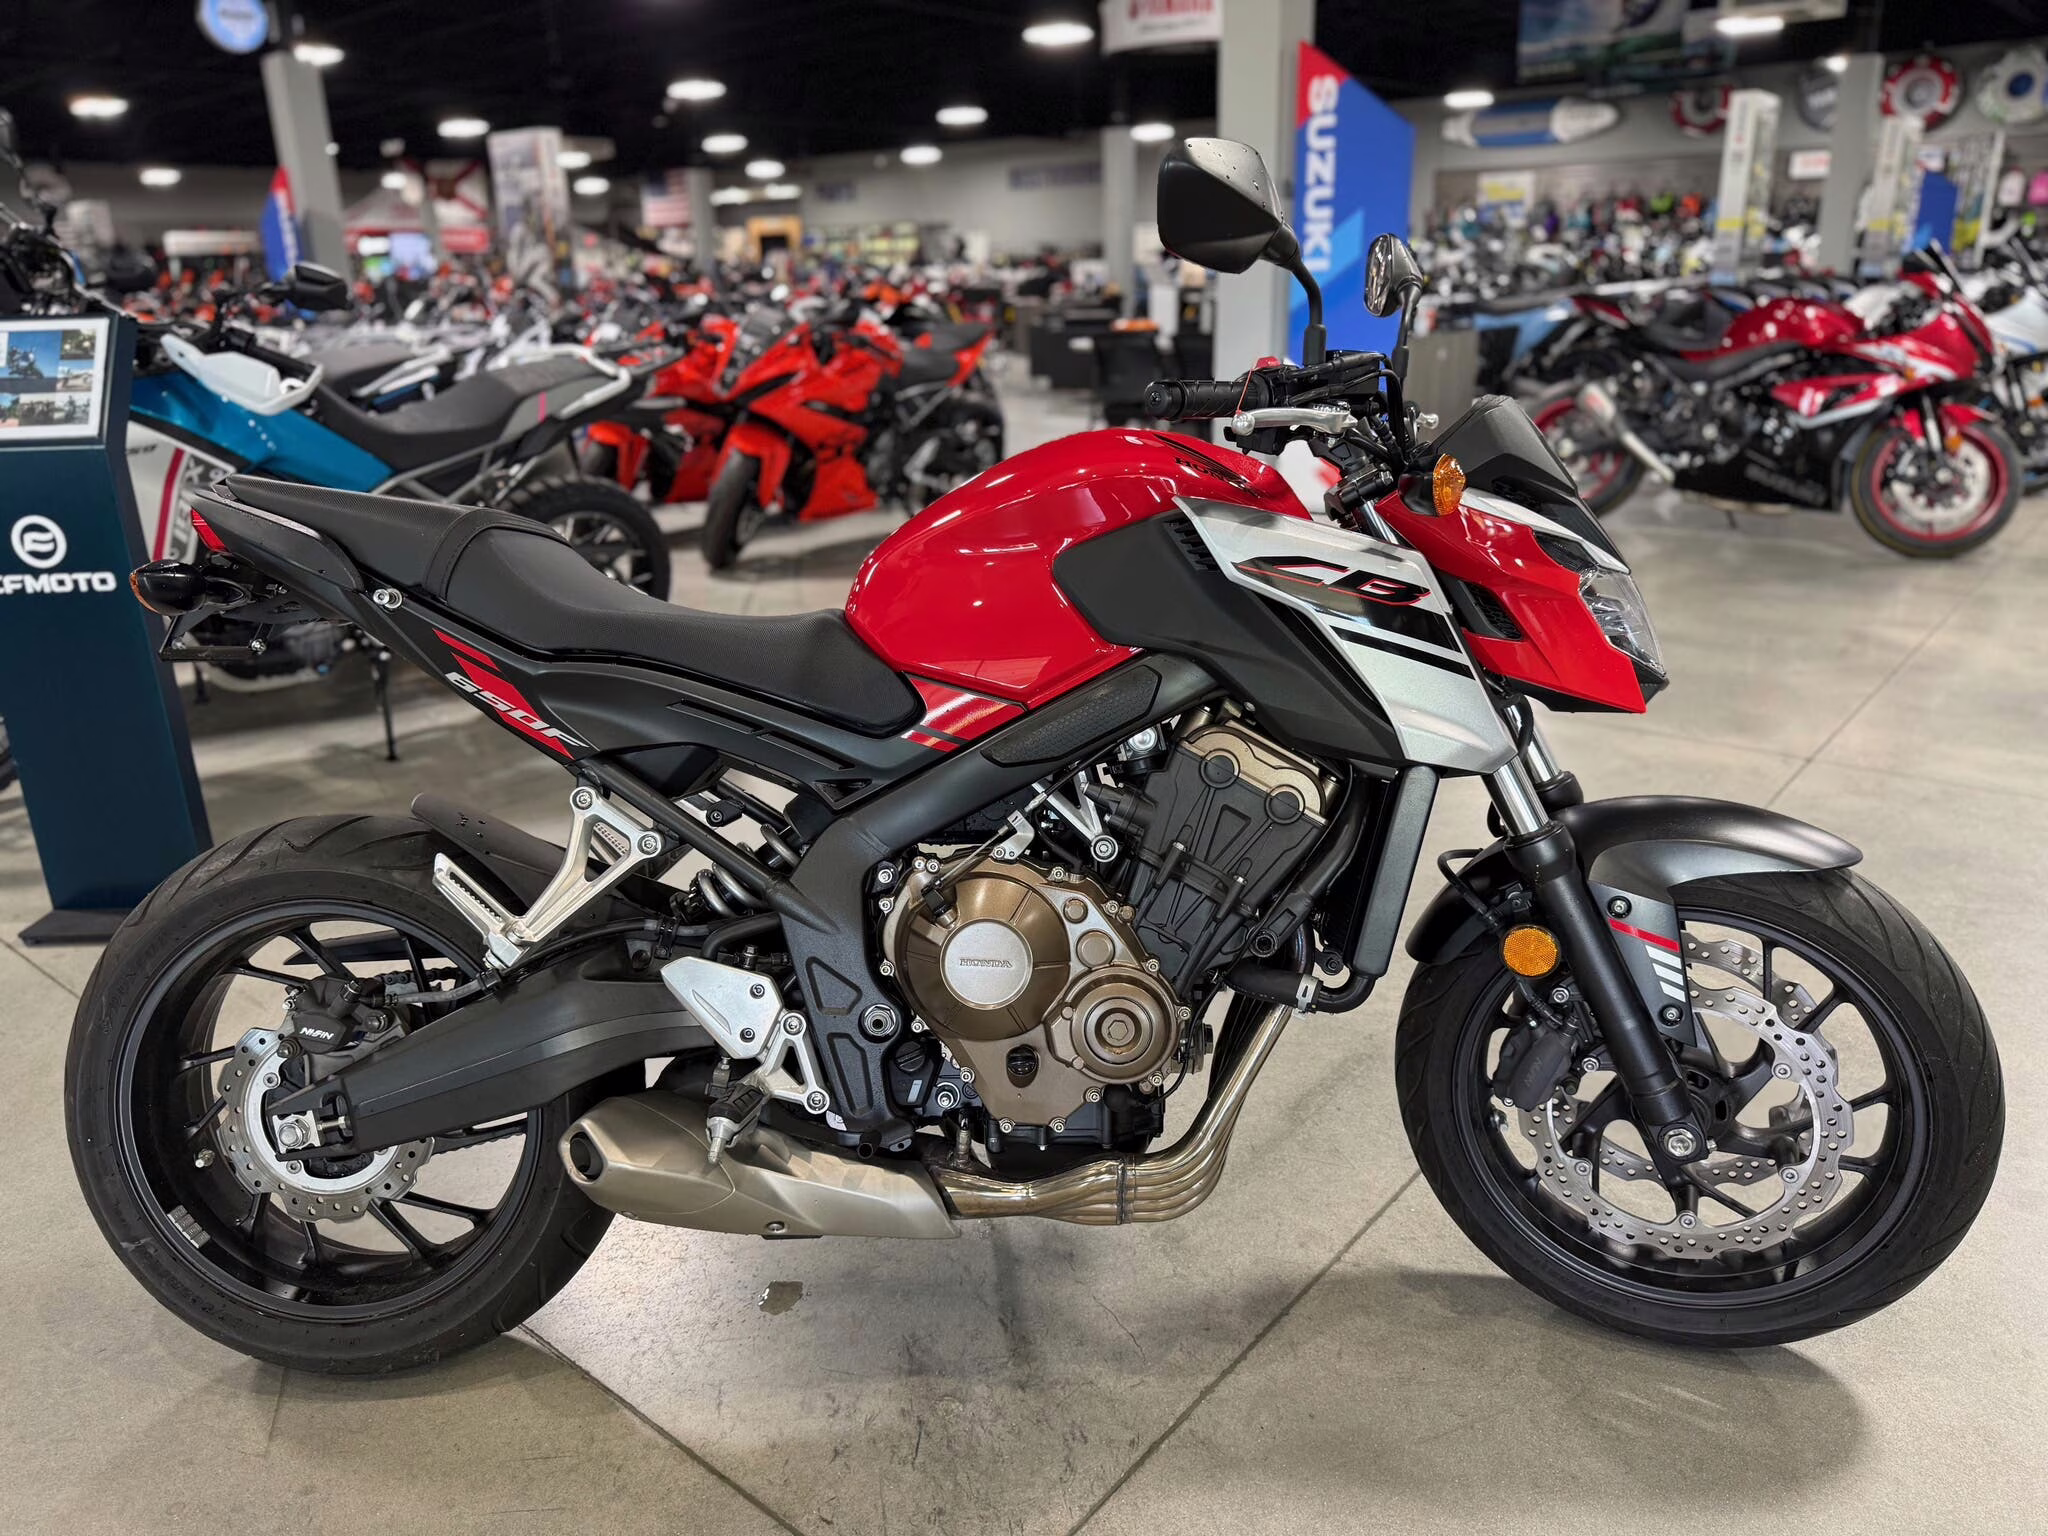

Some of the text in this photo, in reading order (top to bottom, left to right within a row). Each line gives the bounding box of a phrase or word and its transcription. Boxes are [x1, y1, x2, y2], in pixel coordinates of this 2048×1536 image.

[1303, 74, 1340, 271] SUZUKI
[0, 571, 118, 595] FMOTO
[1229, 556, 1433, 606] CB
[445, 671, 590, 748] 650F
[959, 958, 1014, 969] HONDA
